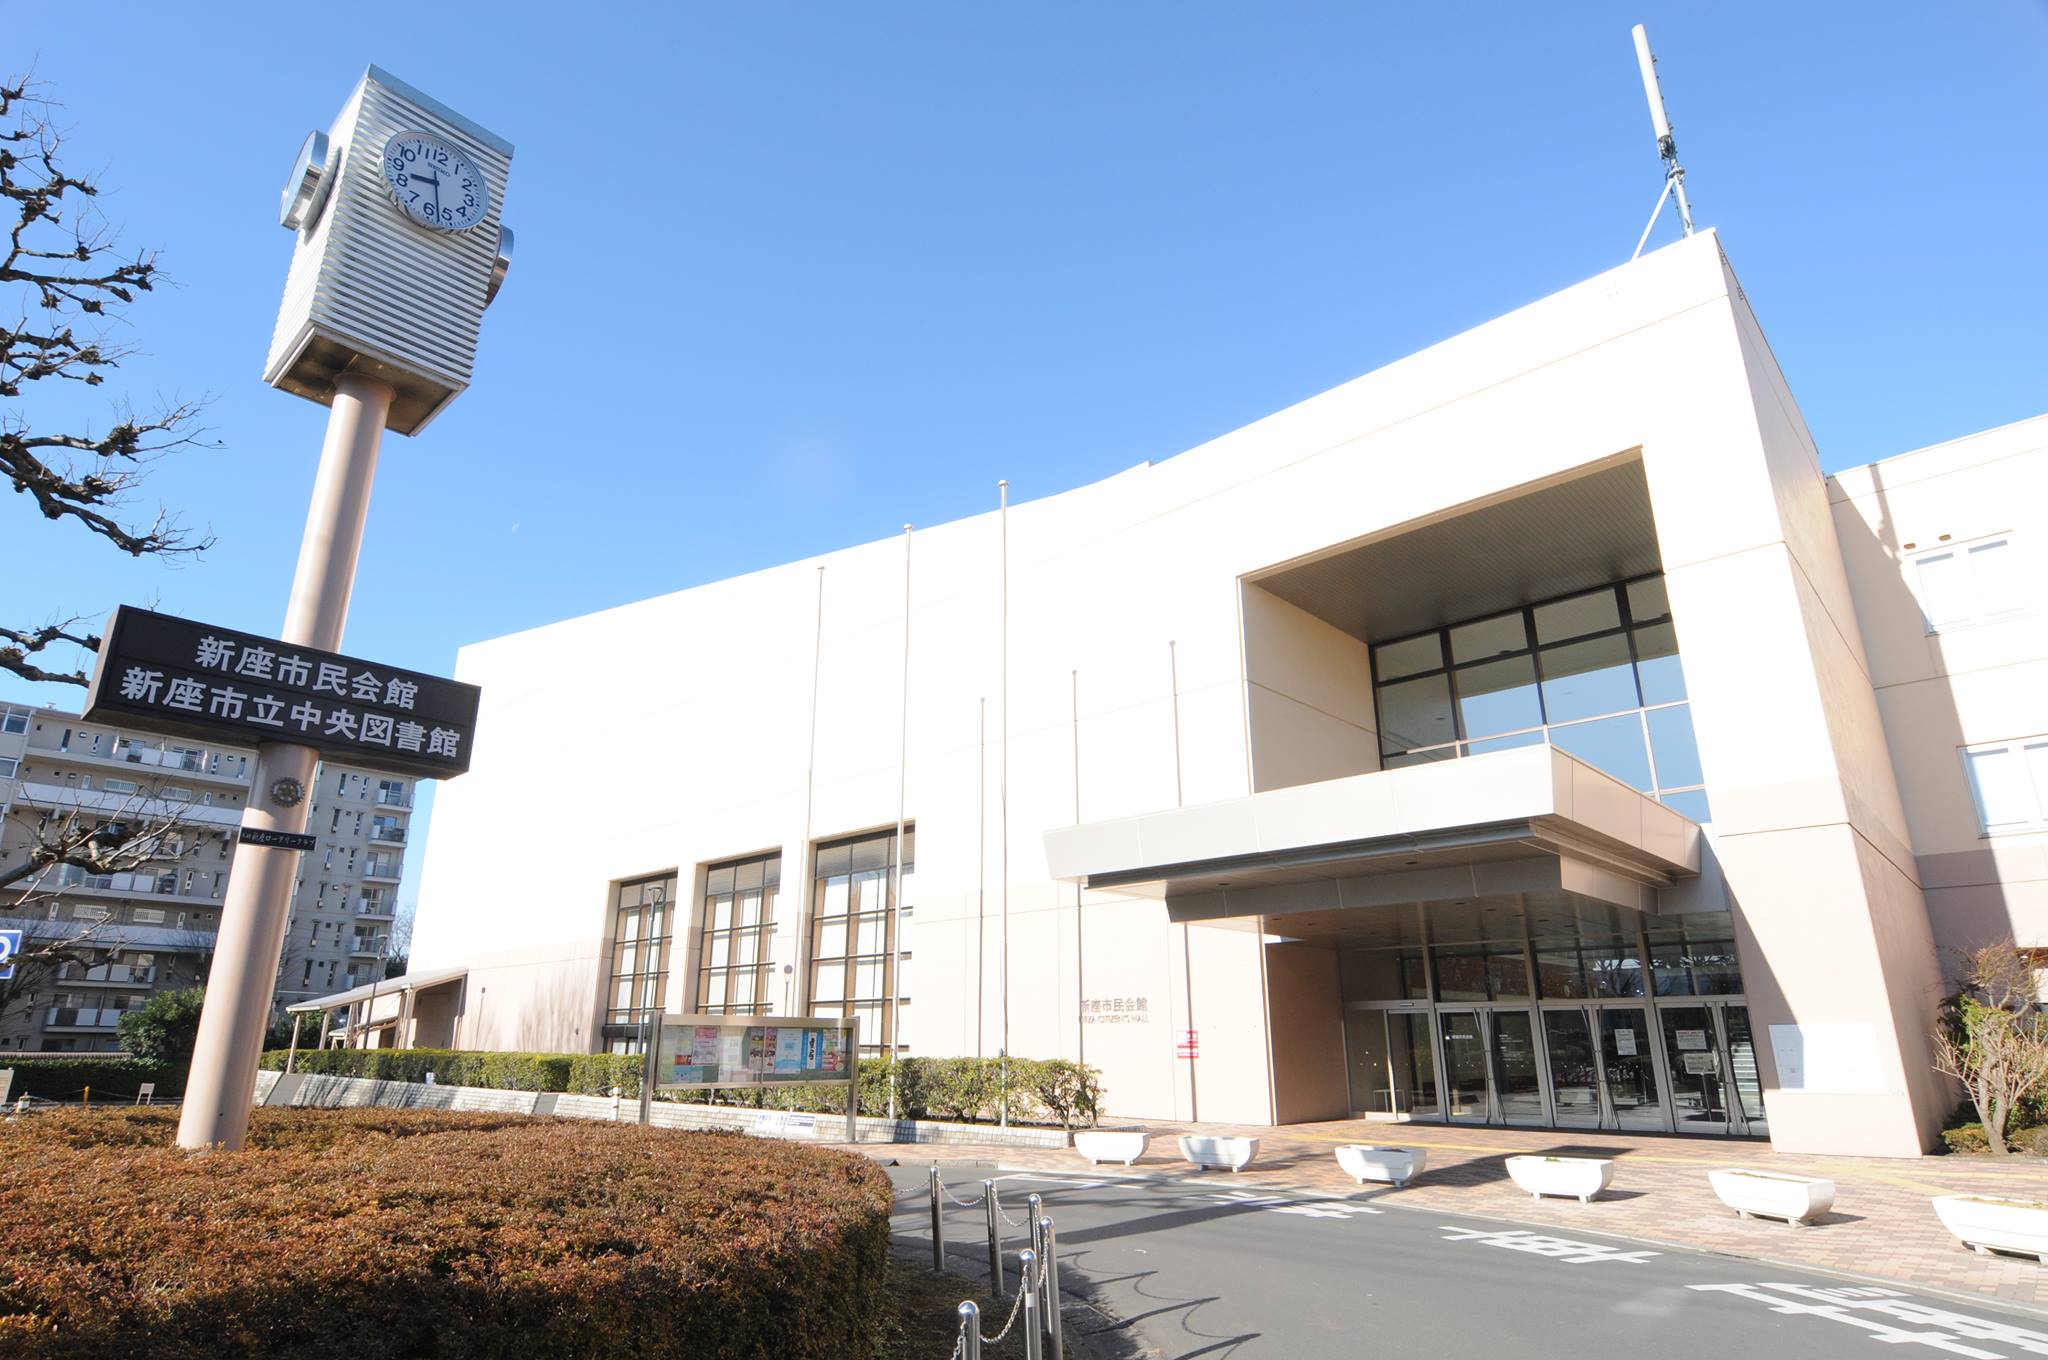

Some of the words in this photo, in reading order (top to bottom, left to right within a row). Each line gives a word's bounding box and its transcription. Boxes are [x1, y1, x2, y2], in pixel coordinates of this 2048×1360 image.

[400, 146, 416, 162] 10
[418, 143, 430, 159] 11
[433, 149, 449, 167] 12
[393, 159, 405, 171] 9
[396, 173, 408, 187] 8
[462, 178, 473, 192] 2
[408, 190, 420, 203] 7
[463, 194, 475, 207] 3
[423, 202, 435, 216] 6
[441, 207, 453, 221] 5
[456, 206, 466, 217] 4
[194, 635, 419, 711] 新座市民会館
[119, 665, 461, 759] 新座市立中央図書館
